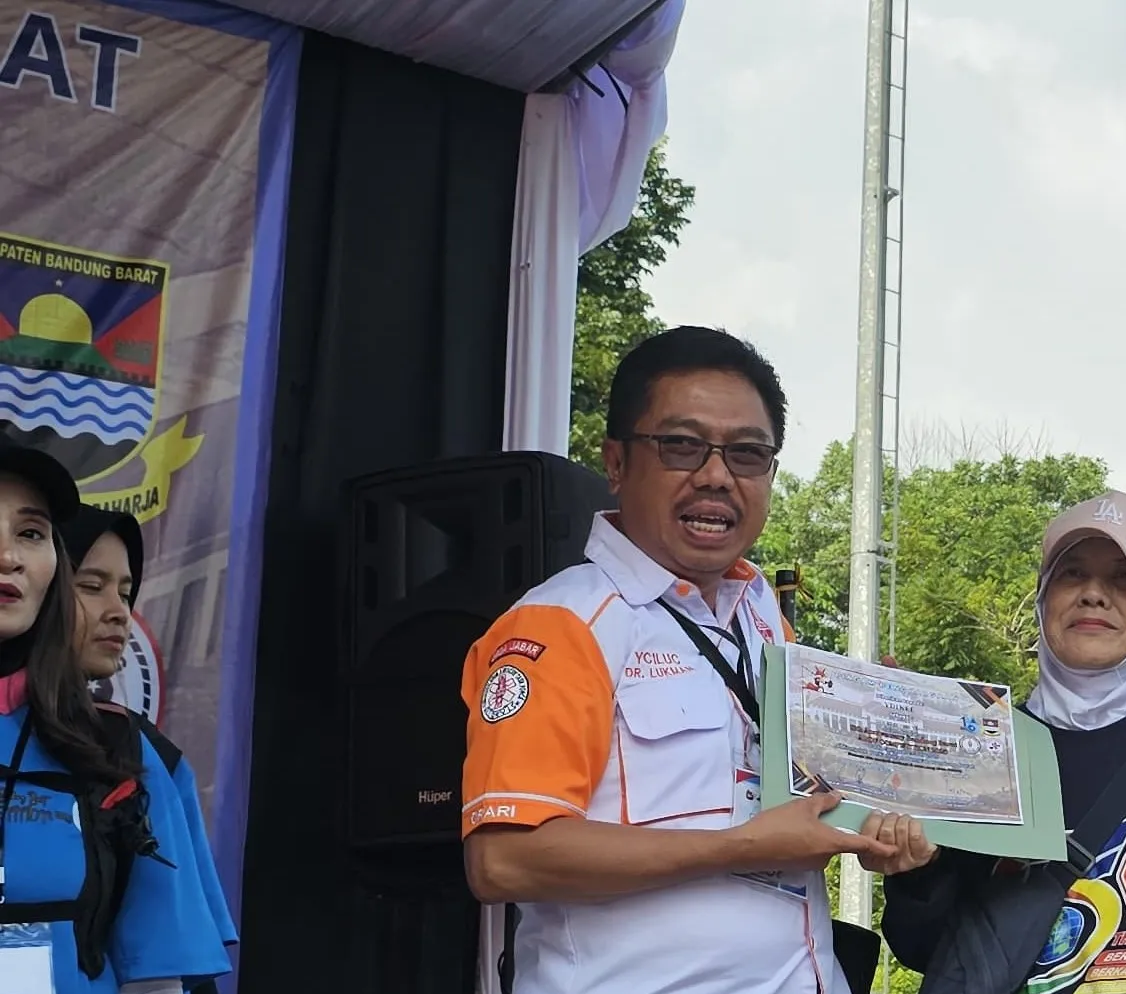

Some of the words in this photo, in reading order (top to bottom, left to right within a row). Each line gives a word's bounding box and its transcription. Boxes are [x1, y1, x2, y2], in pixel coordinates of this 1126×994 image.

[45, 253, 112, 279] BANDUNG
[115, 266, 159, 285] BARAT
[625, 667, 645, 678] DR.
